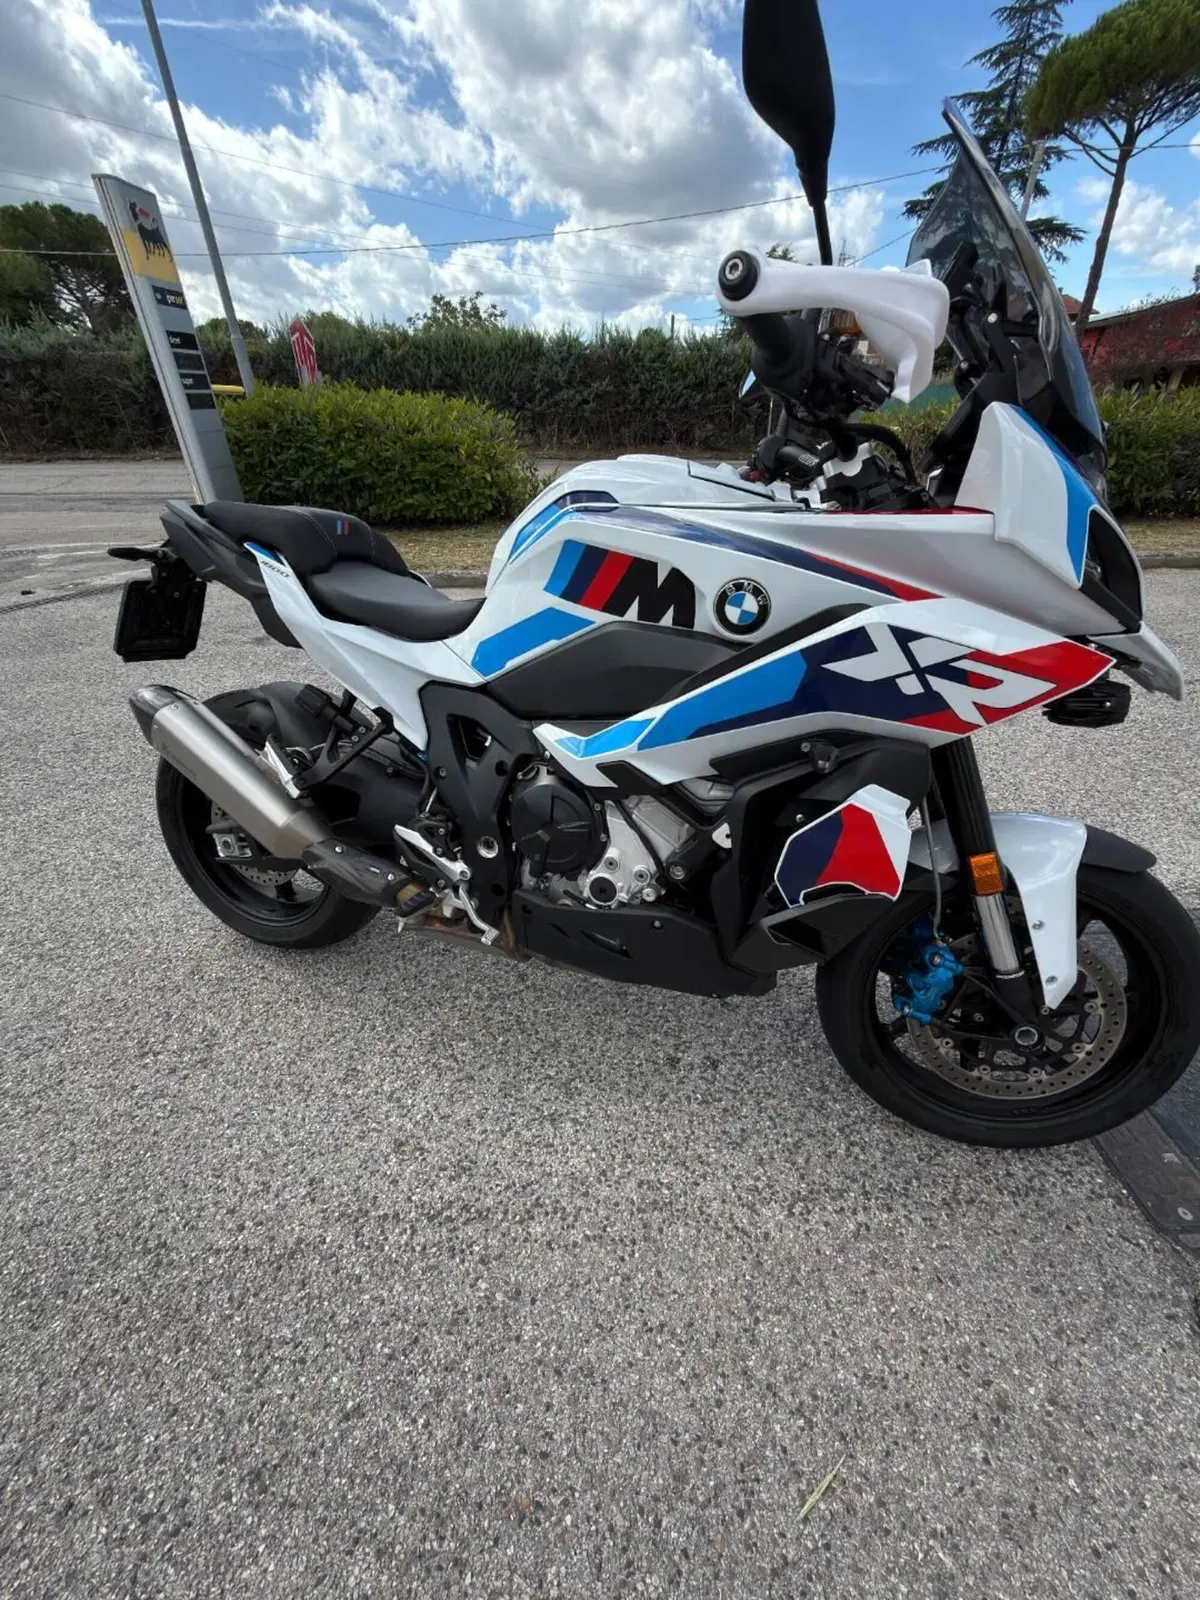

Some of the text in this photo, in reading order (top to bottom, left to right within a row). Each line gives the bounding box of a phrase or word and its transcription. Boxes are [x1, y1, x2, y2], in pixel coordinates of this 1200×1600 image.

[600, 556, 697, 630] M
[725, 580, 771, 606] BMW
[820, 621, 1058, 728] XR
